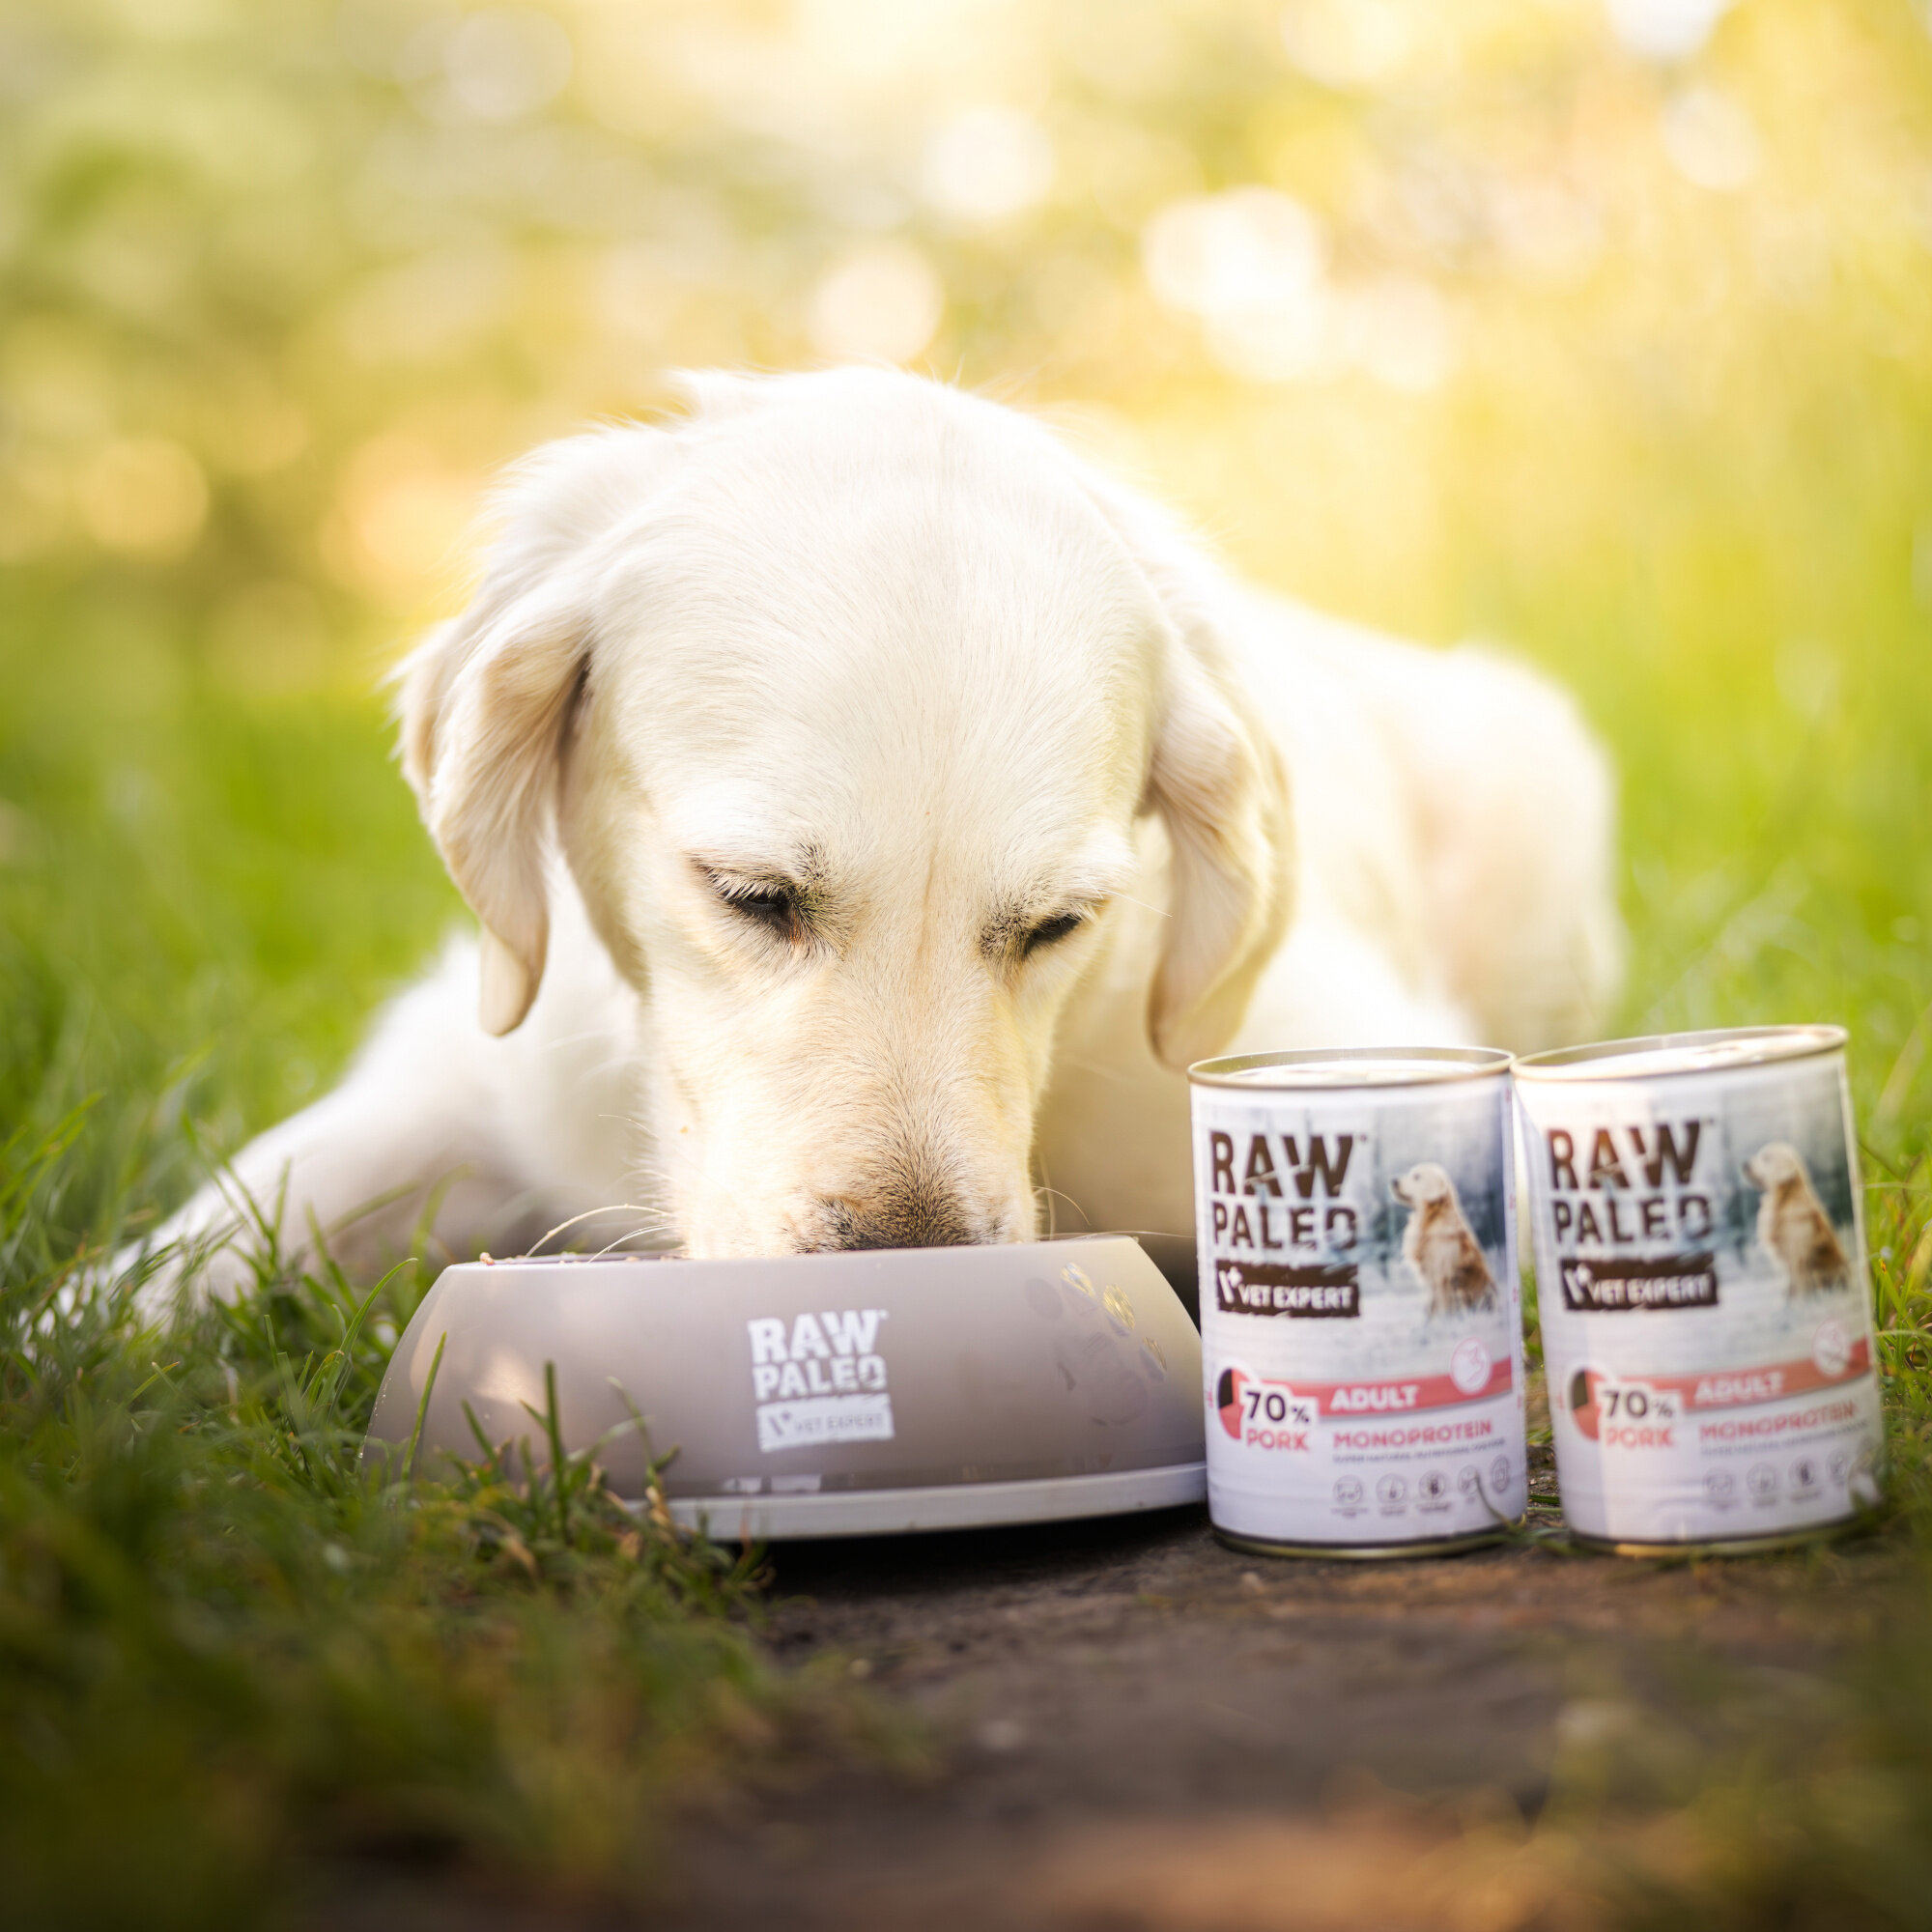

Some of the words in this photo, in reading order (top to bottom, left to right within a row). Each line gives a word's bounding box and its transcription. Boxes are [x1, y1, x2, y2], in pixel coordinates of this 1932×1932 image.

[1209, 1130, 1353, 1198] RAW
[1548, 1121, 1699, 1189] RAW
[1212, 1200, 1357, 1250] PALEO
[1551, 1195, 1712, 1244] PALEO
[1238, 1284, 1272, 1307] VET
[1272, 1285, 1353, 1309] EXPERT
[1594, 1279, 1626, 1303] VET
[1627, 1273, 1713, 1302] EXPERT
[748, 1309, 879, 1365] RAW
[753, 1355, 887, 1401] PALEO
[1694, 1371, 1784, 1402] ADULT
[1244, 1390, 1310, 1423] 70%
[1329, 1384, 1420, 1410] ADULT
[1604, 1389, 1673, 1419] 70%
[794, 1418, 821, 1434] VET
[828, 1412, 884, 1431] EXPERT
[1333, 1418, 1492, 1450] MONOPROTEIN
[1605, 1425, 1674, 1448] PORK
[1699, 1401, 1858, 1441] MONOPROTEIN
[1246, 1428, 1309, 1452] PORK
